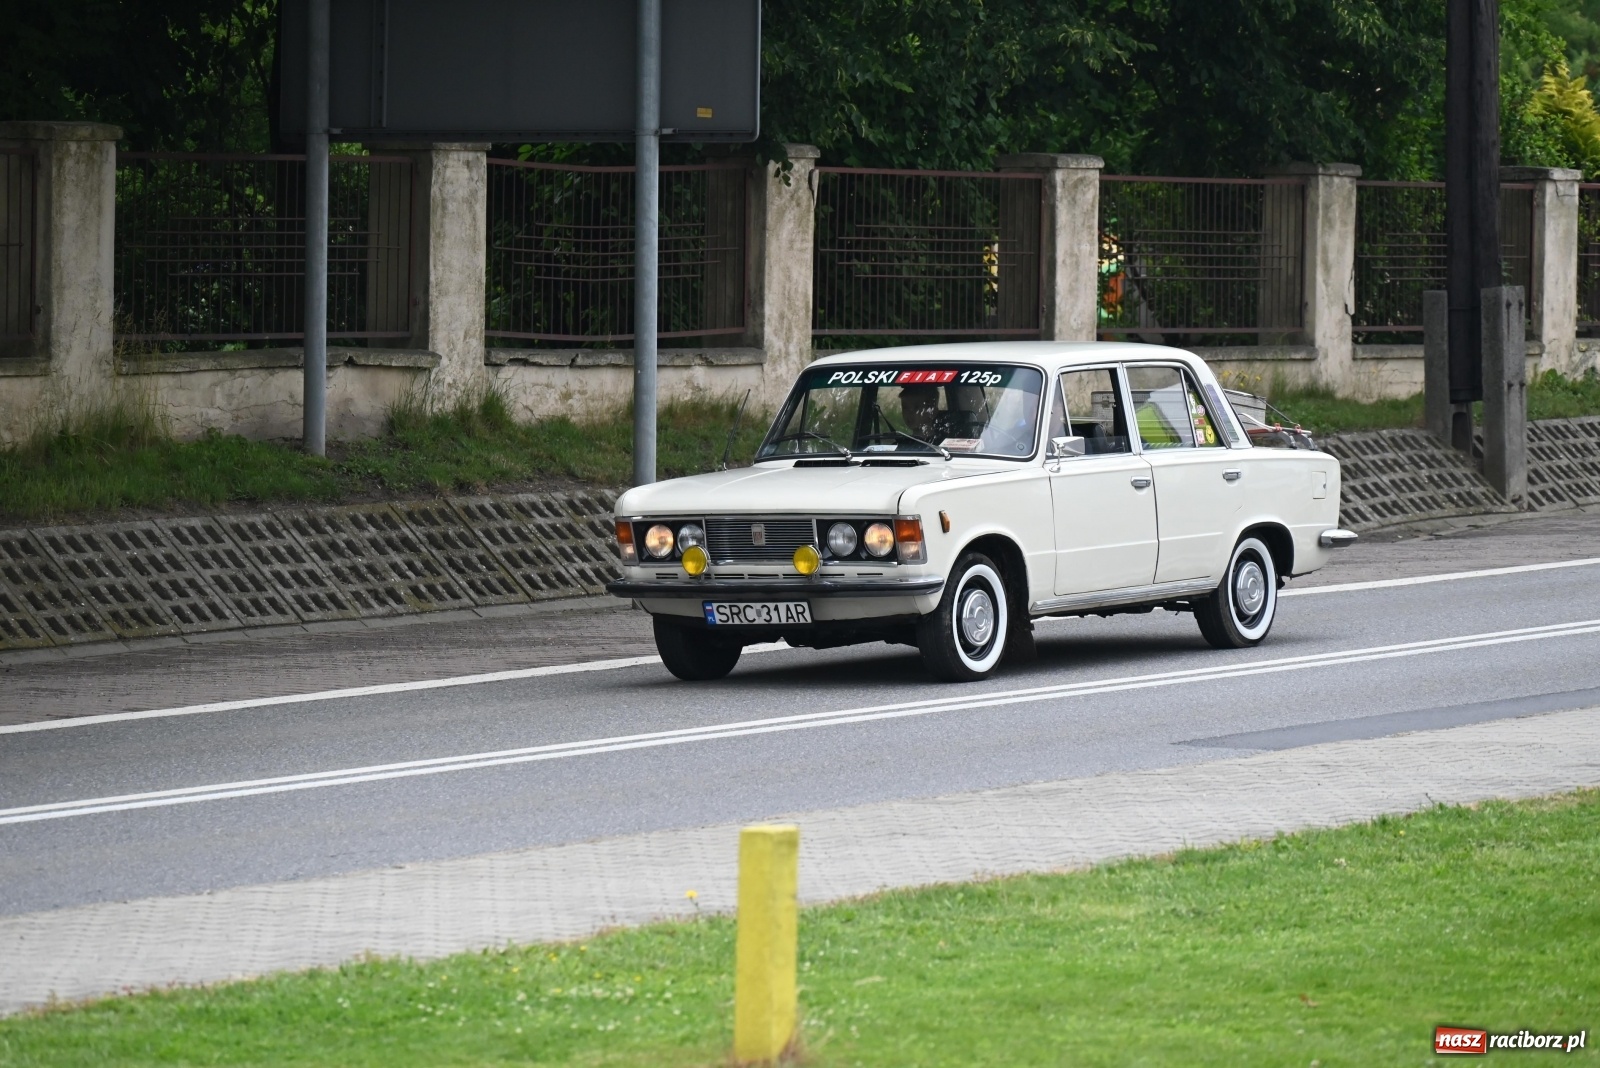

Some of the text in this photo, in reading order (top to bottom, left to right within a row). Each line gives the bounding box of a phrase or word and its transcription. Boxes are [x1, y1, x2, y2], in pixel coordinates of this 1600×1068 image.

[827, 371, 1002, 386] POLSKI FIAT 125p
[716, 604, 808, 623] SRC 31AR
